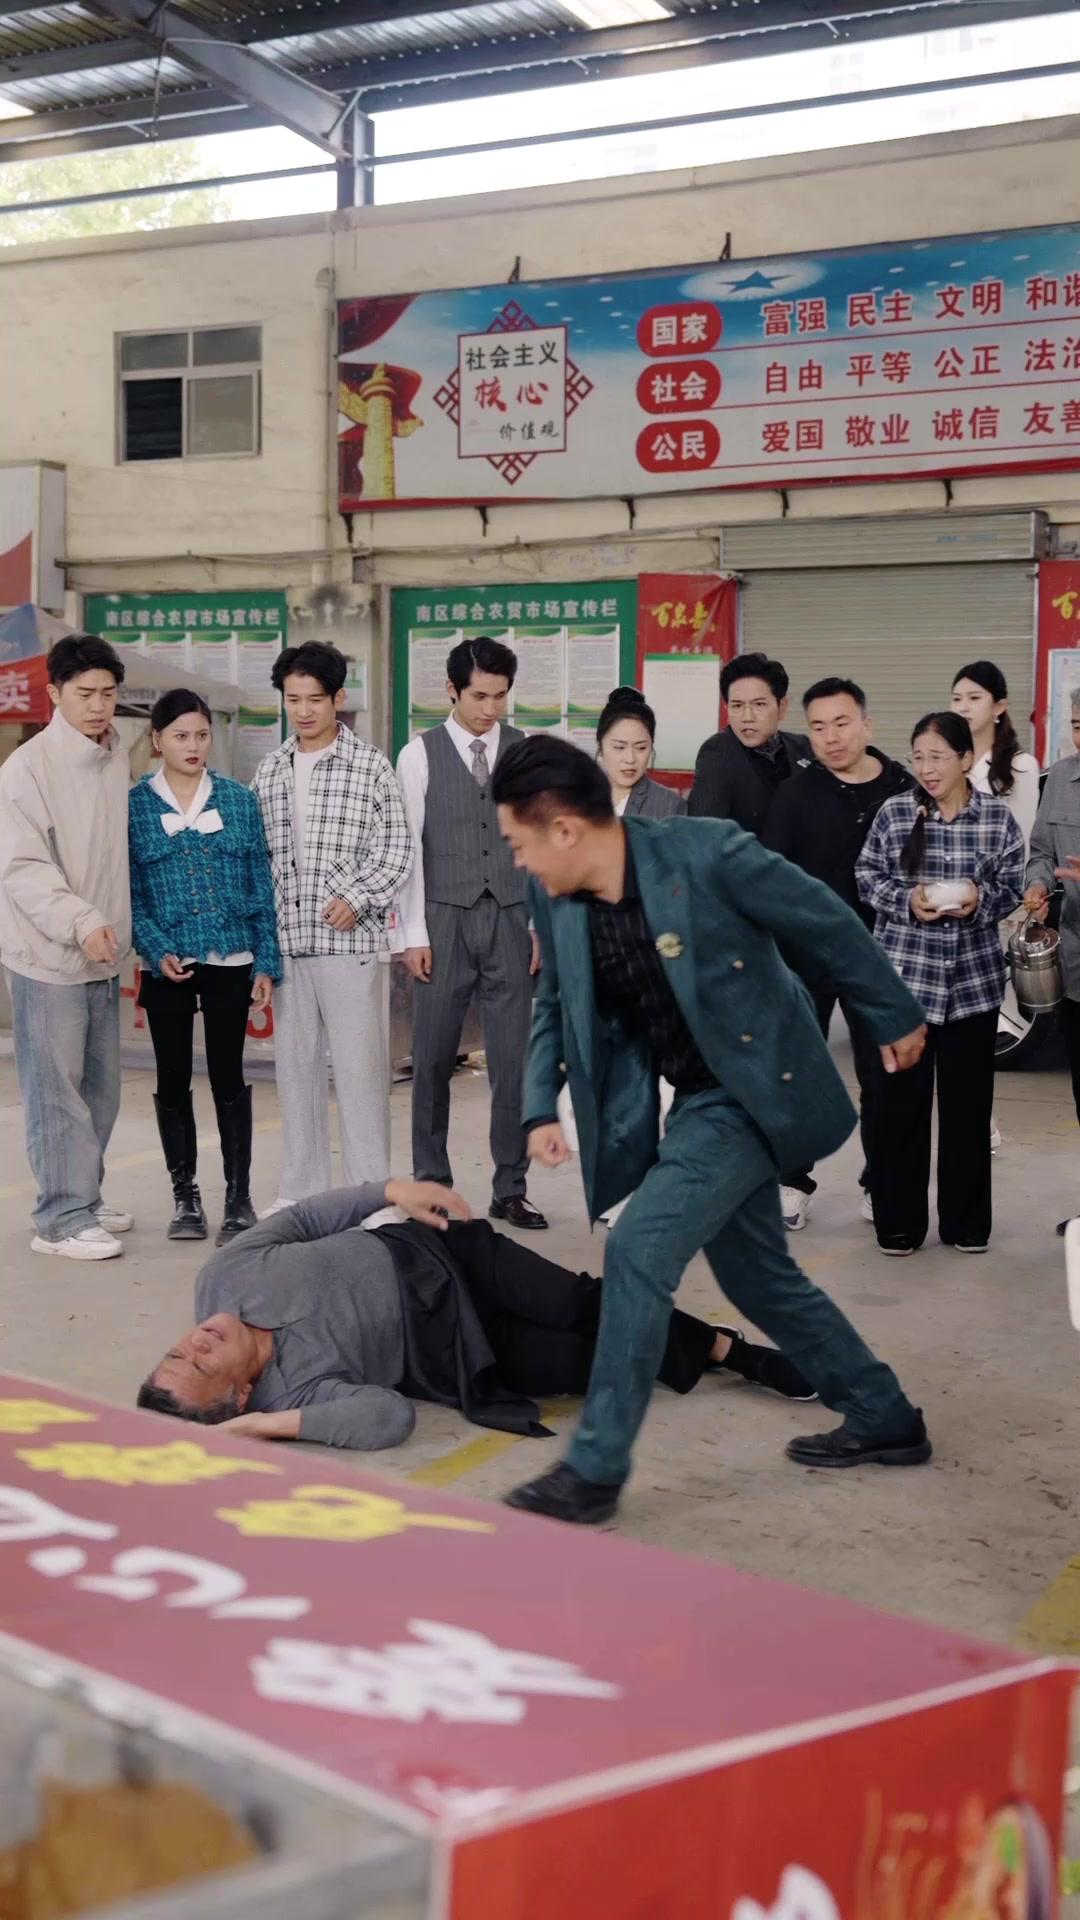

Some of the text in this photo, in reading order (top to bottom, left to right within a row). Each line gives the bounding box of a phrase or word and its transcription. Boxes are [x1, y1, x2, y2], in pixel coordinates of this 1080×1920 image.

[762, 299, 827, 337] 富强
[847, 291, 913, 329] 民主
[935, 281, 1004, 321] 文明
[652, 313, 708, 347] 国家
[466, 341, 560, 372] 社会主义
[765, 359, 823, 395] 自由
[846, 352, 912, 387] 平等
[934, 345, 1001, 379] 公正
[475, 378, 550, 412] 核心
[651, 371, 708, 404] 社会
[499, 420, 560, 441] 价值观
[762, 419, 824, 453] 爱国
[845, 413, 910, 448] 敬业
[932, 406, 1000, 441] 诚信
[651, 430, 707, 462] 公民
[105, 608, 281, 627] 南区综合农贸市场宣传栏
[416, 598, 618, 624] 南区综合农贸市场宣传栏
[1052, 591, 1080, 620] 百
